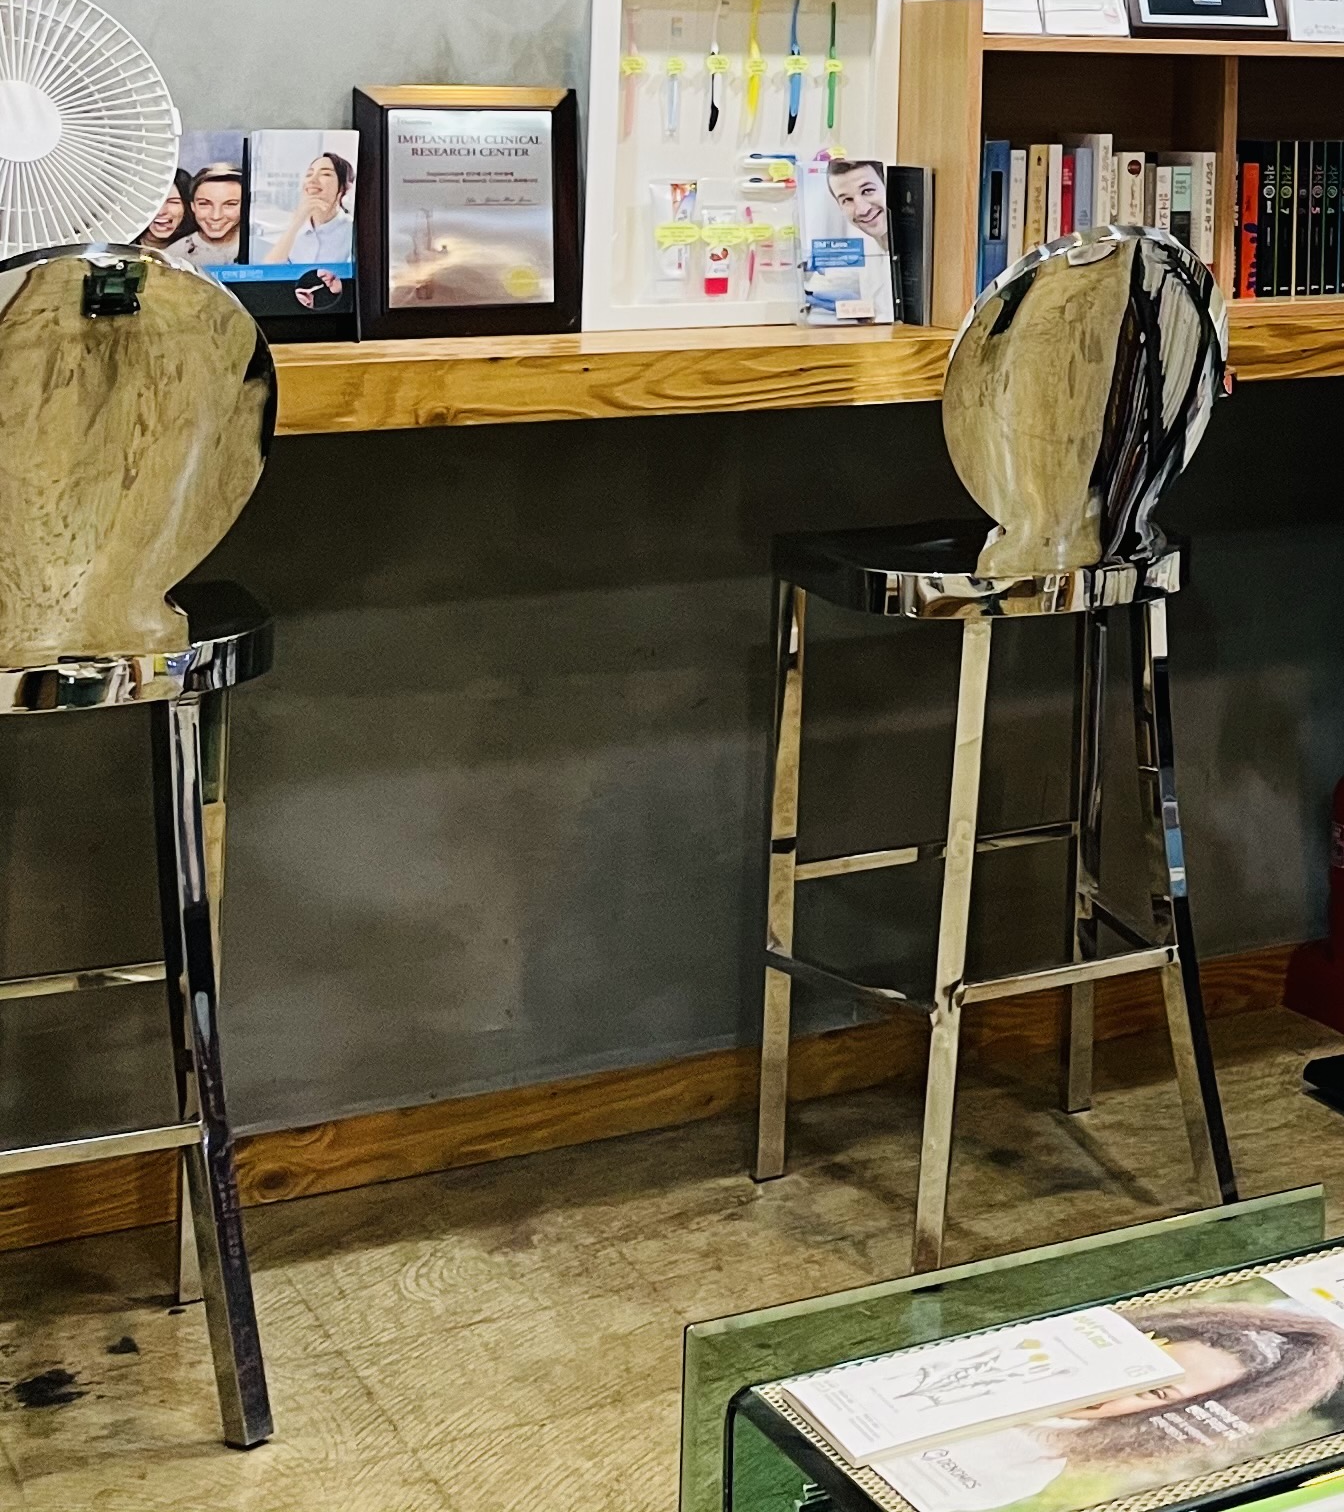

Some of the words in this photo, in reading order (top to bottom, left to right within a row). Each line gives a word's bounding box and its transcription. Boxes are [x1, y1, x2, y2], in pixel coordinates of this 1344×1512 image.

[397, 135, 482, 145] IMPLANTIUM
[484, 135, 543, 145] CLINICAL
[411, 147, 477, 157] RESEARCH
[479, 148, 530, 157] CENTER
